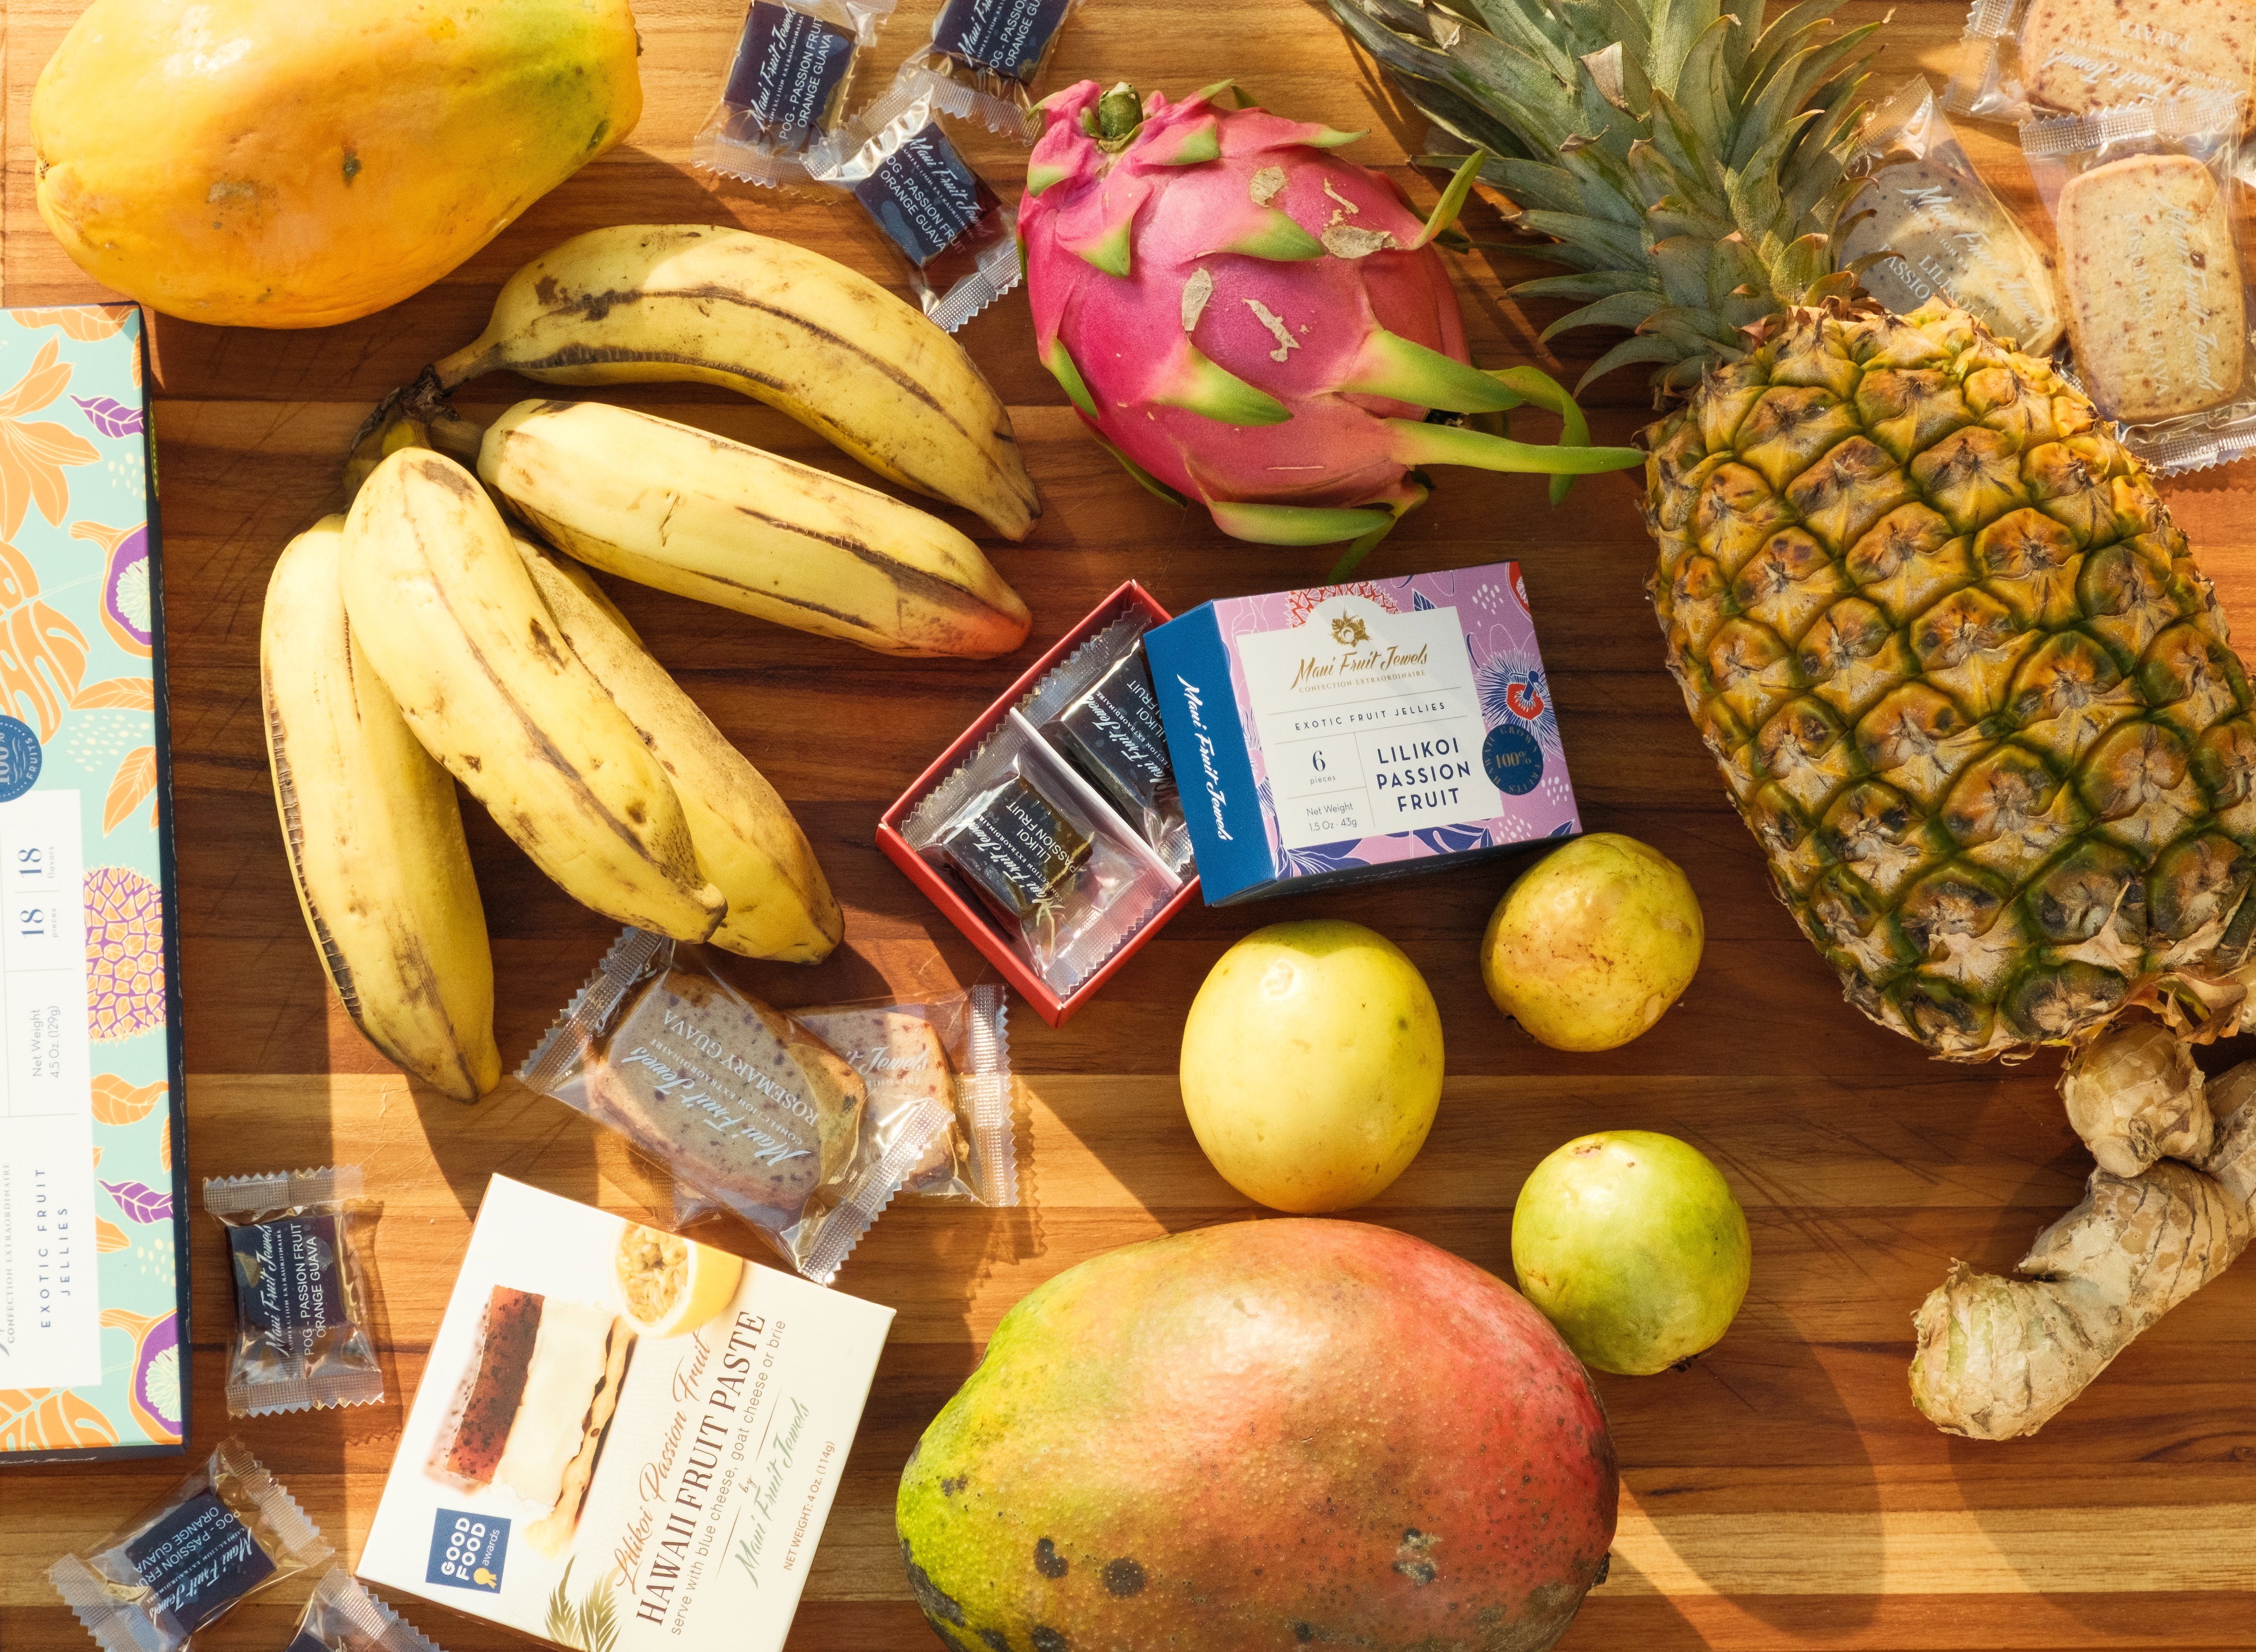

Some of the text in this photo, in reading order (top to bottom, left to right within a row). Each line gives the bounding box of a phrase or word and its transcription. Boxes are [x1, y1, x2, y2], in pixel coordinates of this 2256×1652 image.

[957, 16, 982, 68] Maui
[986, 50, 1003, 76] POG
[1000, 0, 1026, 43] PASSIO
[1005, 17, 1033, 66] ORANGE
[2119, 20, 2192, 52] PAPAYA
[748, 1, 796, 132] Maui Fruit Jewels
[779, 15, 824, 139] POG PASSION FRUIT
[797, 34, 834, 127] ORANGE GUAVA
[2041, 47, 2118, 83] Jewels
[2108, 70, 2175, 100] Fruit
[886, 156, 966, 254] OG PASSION FRUIT
[931, 167, 968, 201] Fruit
[881, 170, 947, 252] ORANGE GUAVA
[1878, 242, 1930, 303] PASSIO
[2147, 326, 2170, 397] GUAVA
[2187, 321, 2224, 391] Jewels
[1290, 643, 1428, 690] Maui Fruit Jewels
[1299, 670, 1425, 693] CONFECTION EXTRAORDINAIRE
[1127, 680, 1158, 710] FRUIT
[1295, 702, 1445, 731] EXOTIC FRUIT JELLIES
[25, 737, 38, 780] FRUITS
[1109, 730, 1149, 762] Fruit
[1177, 674, 1234, 841] Maui Fruit Jewels
[1312, 750, 1326, 772] 6
[1377, 737, 1459, 764] LILIKOI
[1496, 751, 1531, 769] 100%
[1310, 775, 1336, 786] pieces
[1376, 761, 1471, 790] PASSION
[1397, 788, 1459, 812] FRUIT
[1306, 802, 1354, 817] Net Weight
[1309, 817, 1358, 832] 1.5 Oz 43g
[1005, 801, 1080, 873] PASSION FRUIT
[1016, 828, 1051, 863] LILIKOI
[18, 848, 42, 878] 18
[47, 845, 55, 879] flavors
[990, 850, 1031, 882] Fruit
[20, 908, 45, 939] 18
[51, 907, 59, 938] pieces
[29, 1009, 44, 1077] Net Weight
[47, 1005, 61, 1078] 4.5 Oz. (129g)
[858, 1045, 930, 1075] Jewels
[663, 1009, 821, 1127] ROSEMARY GUAVA
[621, 1046, 812, 1167] Maui Fruit Jewels
[2, 1162, 15, 1344] CONFECTION EXTRAORDINAIRE
[35, 1169, 51, 1328] EXOTIC FRUIT
[58, 1208, 70, 1297] JELLIES
[254, 1224, 290, 1358] Maui Fruit Jewels
[290, 1223, 314, 1356] POG PASSION FRUIT
[306, 1236, 327, 1338] ORANGE GUAVA
[614, 1321, 711, 1595] Lilikoi Passion Fruit
[636, 1311, 766, 1626] HAWAII FRUIT PASTE
[671, 1320, 786, 1635] serve with blue cheese, goat cheese or brie
[816, 1441, 836, 1475] (114g)
[735, 1397, 810, 1590] Maui Fruit Jewels
[738, 1474, 758, 1494] by
[810, 1477, 823, 1494] Oz.
[132, 1507, 219, 1574] ORANGE GUAVA
[134, 1509, 241, 1591] POG PASSION FRUI
[441, 1517, 471, 1576] GOOD
[482, 1529, 500, 1567] awards
[790, 1503, 814, 1548] WEIGHT:
[149, 1526, 253, 1627] Maui Fruit Jewels
[456, 1523, 486, 1581] FOOD
[783, 1549, 799, 1571] NET
